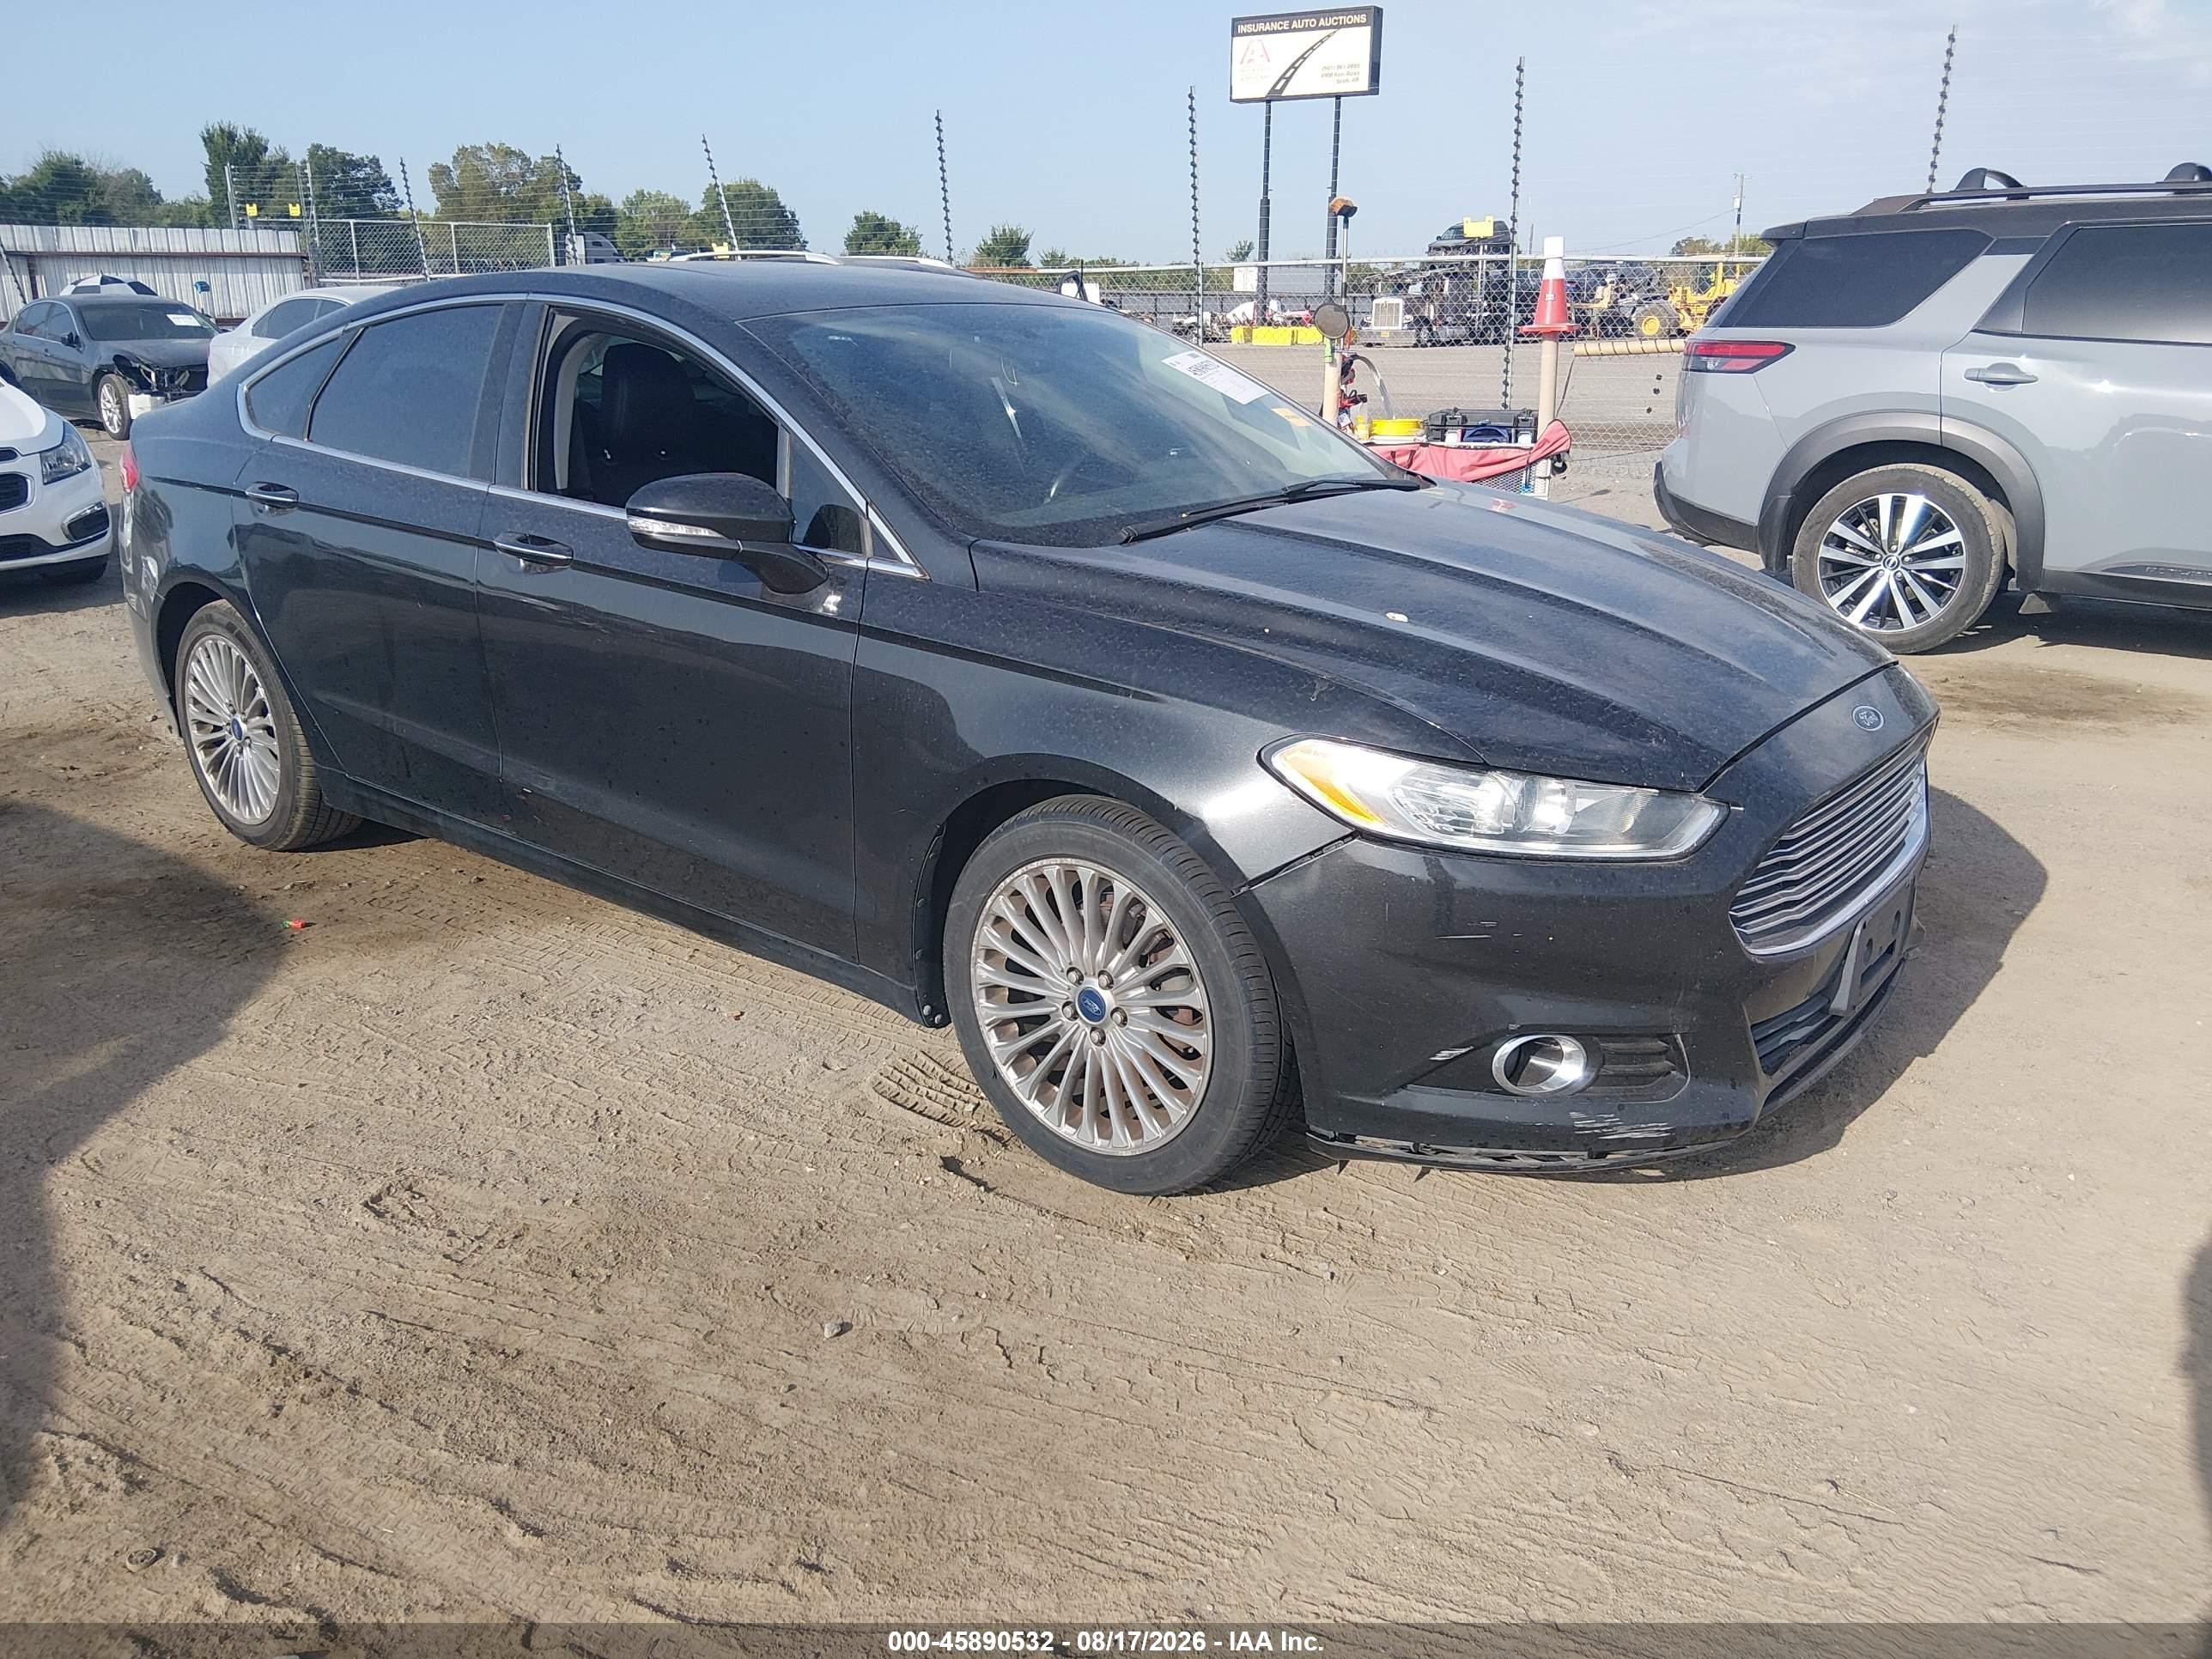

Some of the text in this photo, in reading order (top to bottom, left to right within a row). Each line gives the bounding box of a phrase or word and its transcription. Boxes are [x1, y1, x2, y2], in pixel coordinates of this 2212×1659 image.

[1237, 14, 1367, 33] INSURANCE AUTO AUCTIONS
